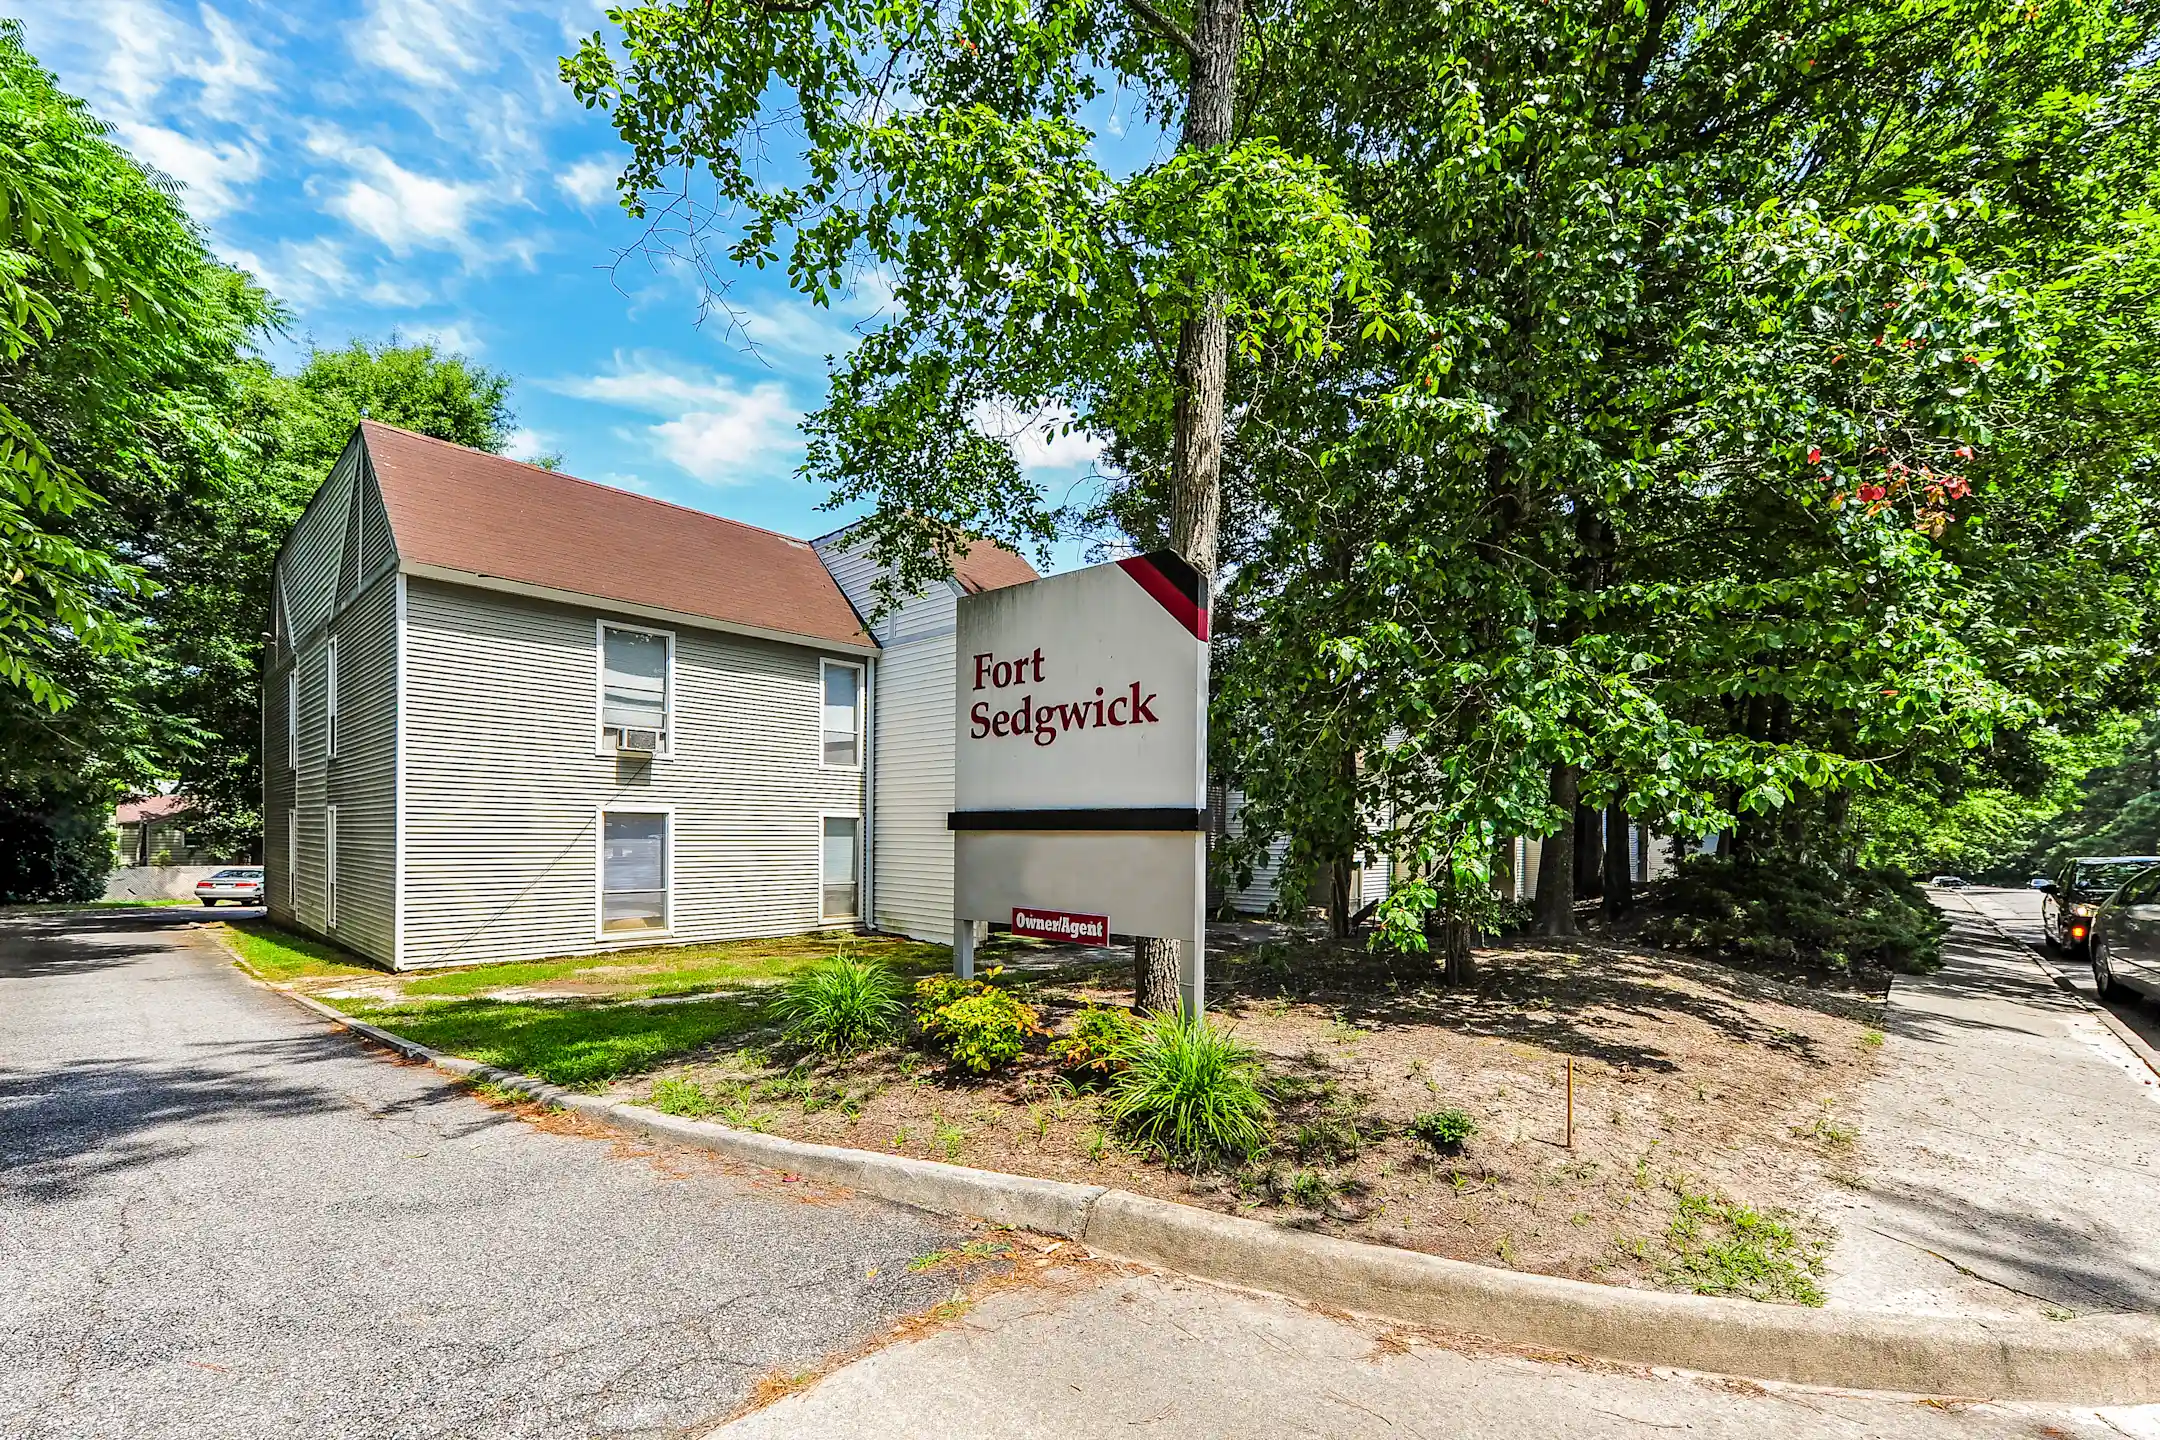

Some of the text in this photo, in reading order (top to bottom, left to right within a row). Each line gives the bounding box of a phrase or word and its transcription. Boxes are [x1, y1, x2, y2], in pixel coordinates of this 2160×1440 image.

[973, 648, 1045, 690] Fort
[971, 682, 1159, 746] Sedgwick
[1016, 912, 1103, 938] Owner/Agent
